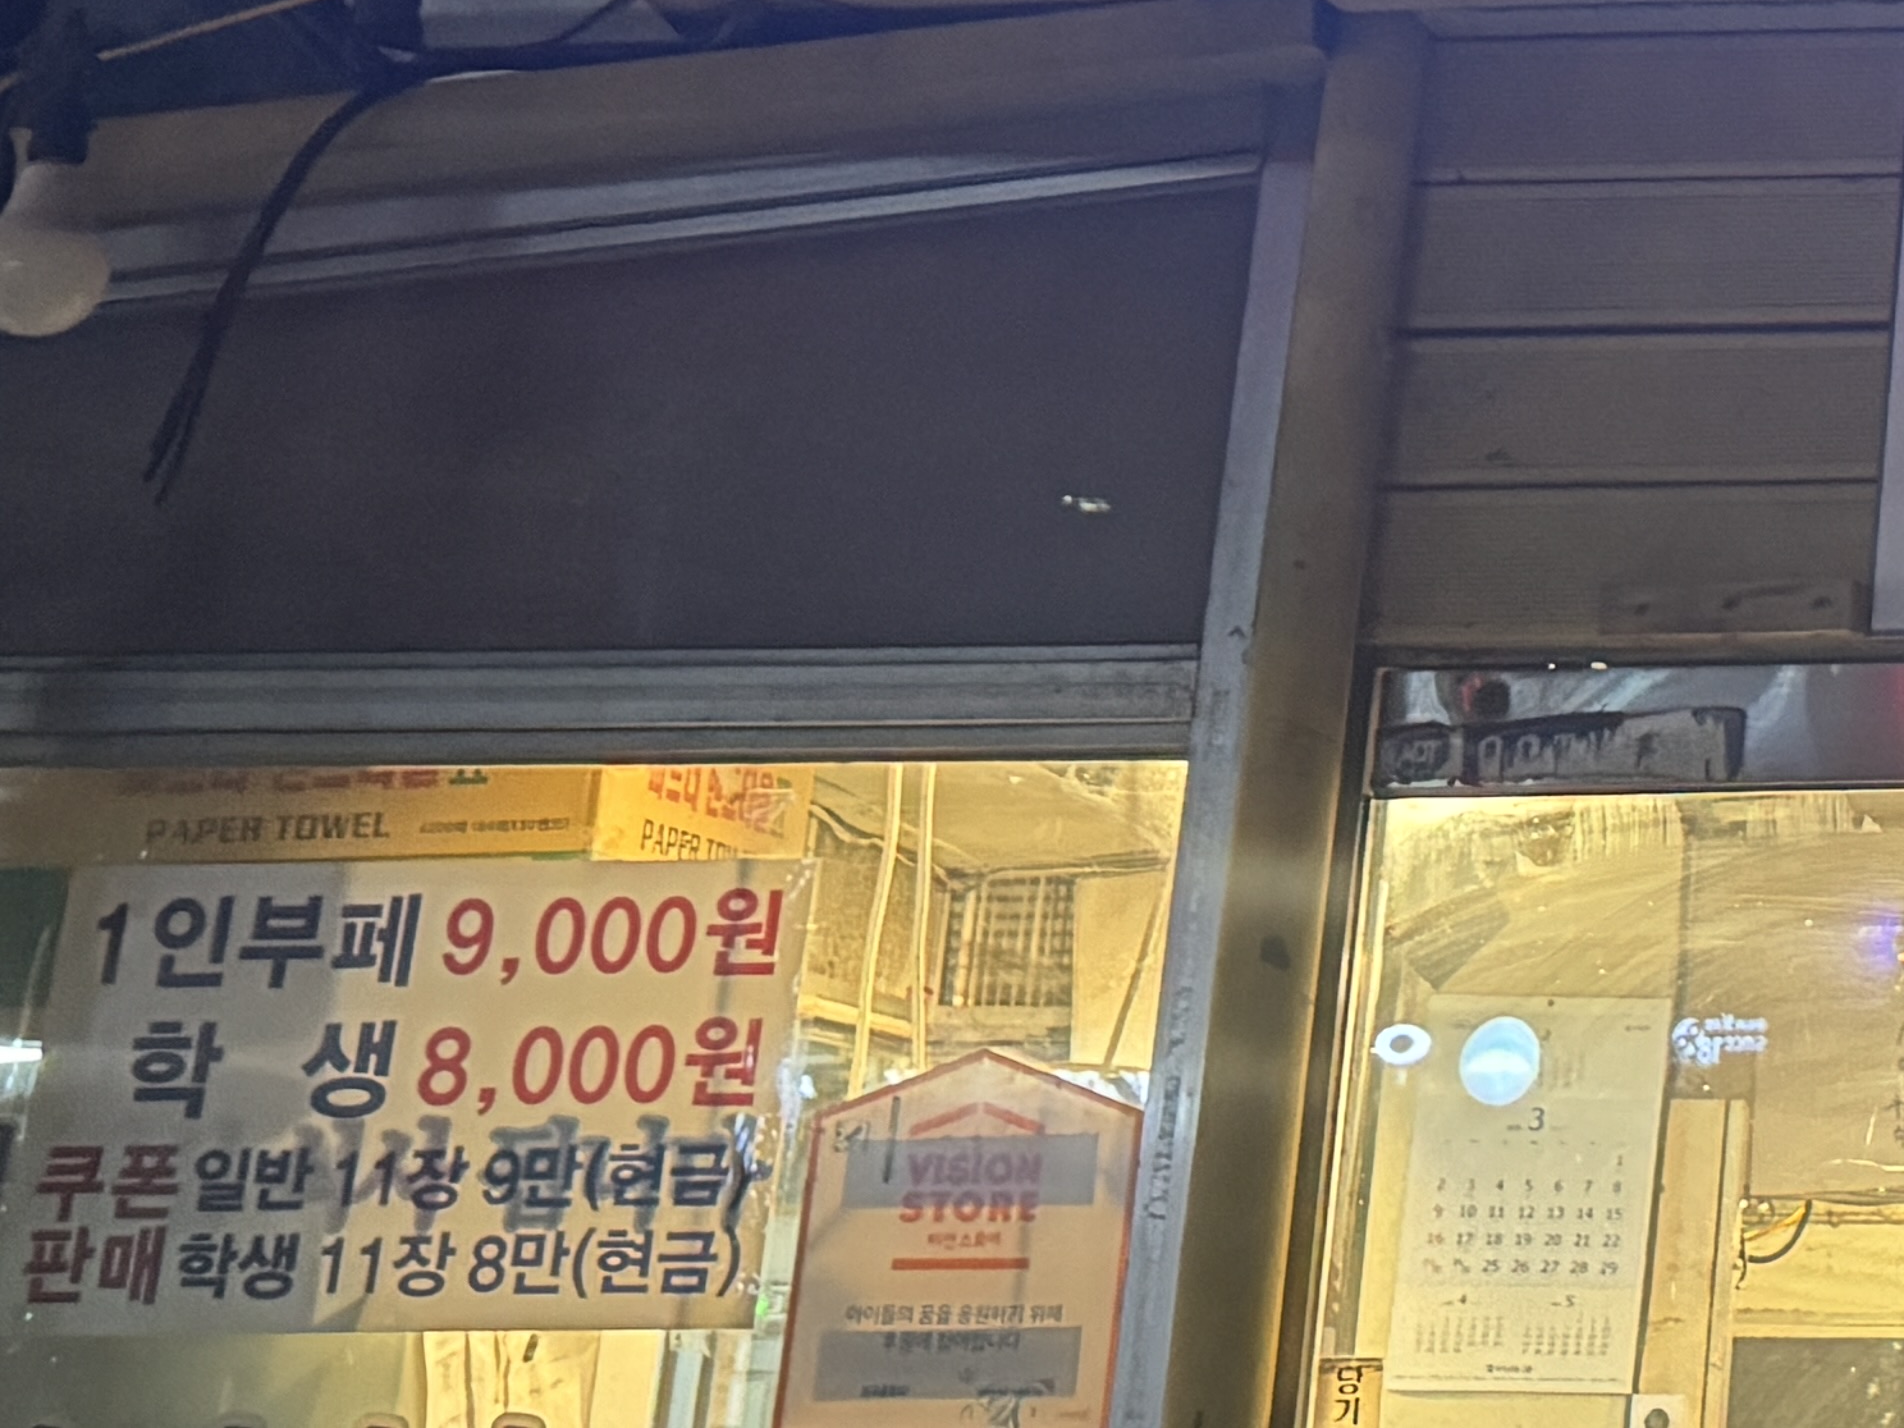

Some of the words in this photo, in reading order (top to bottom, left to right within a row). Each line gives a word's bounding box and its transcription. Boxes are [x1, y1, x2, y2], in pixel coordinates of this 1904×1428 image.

[143, 815, 264, 843] PAPER
[274, 812, 390, 840] TOWEL
[97, 893, 423, 990] 1인부페
[442, 887, 784, 985] 9,000원
[417, 1016, 764, 1115] 8,000원
[1528, 1107, 1545, 1131] 3
[37, 1144, 180, 1222] 쿠폰
[194, 1146, 314, 1212] 일반
[336, 1145, 469, 1211] 11장
[908, 1152, 1044, 1186] VISION
[899, 1191, 1037, 1223] STORE
[1460, 1204, 1478, 1219] 10
[1519, 1206, 1535, 1220] 12
[1577, 1207, 1594, 1221] 14
[25, 1224, 167, 1306] 판매
[178, 1232, 299, 1300] 학생
[322, 1231, 456, 1297] 11장
[468, 1226, 742, 1299] 8만(현금)
[1482, 1258, 1500, 1274] 25
[1511, 1259, 1529, 1275] 26
[1540, 1260, 1560, 1275] 27
